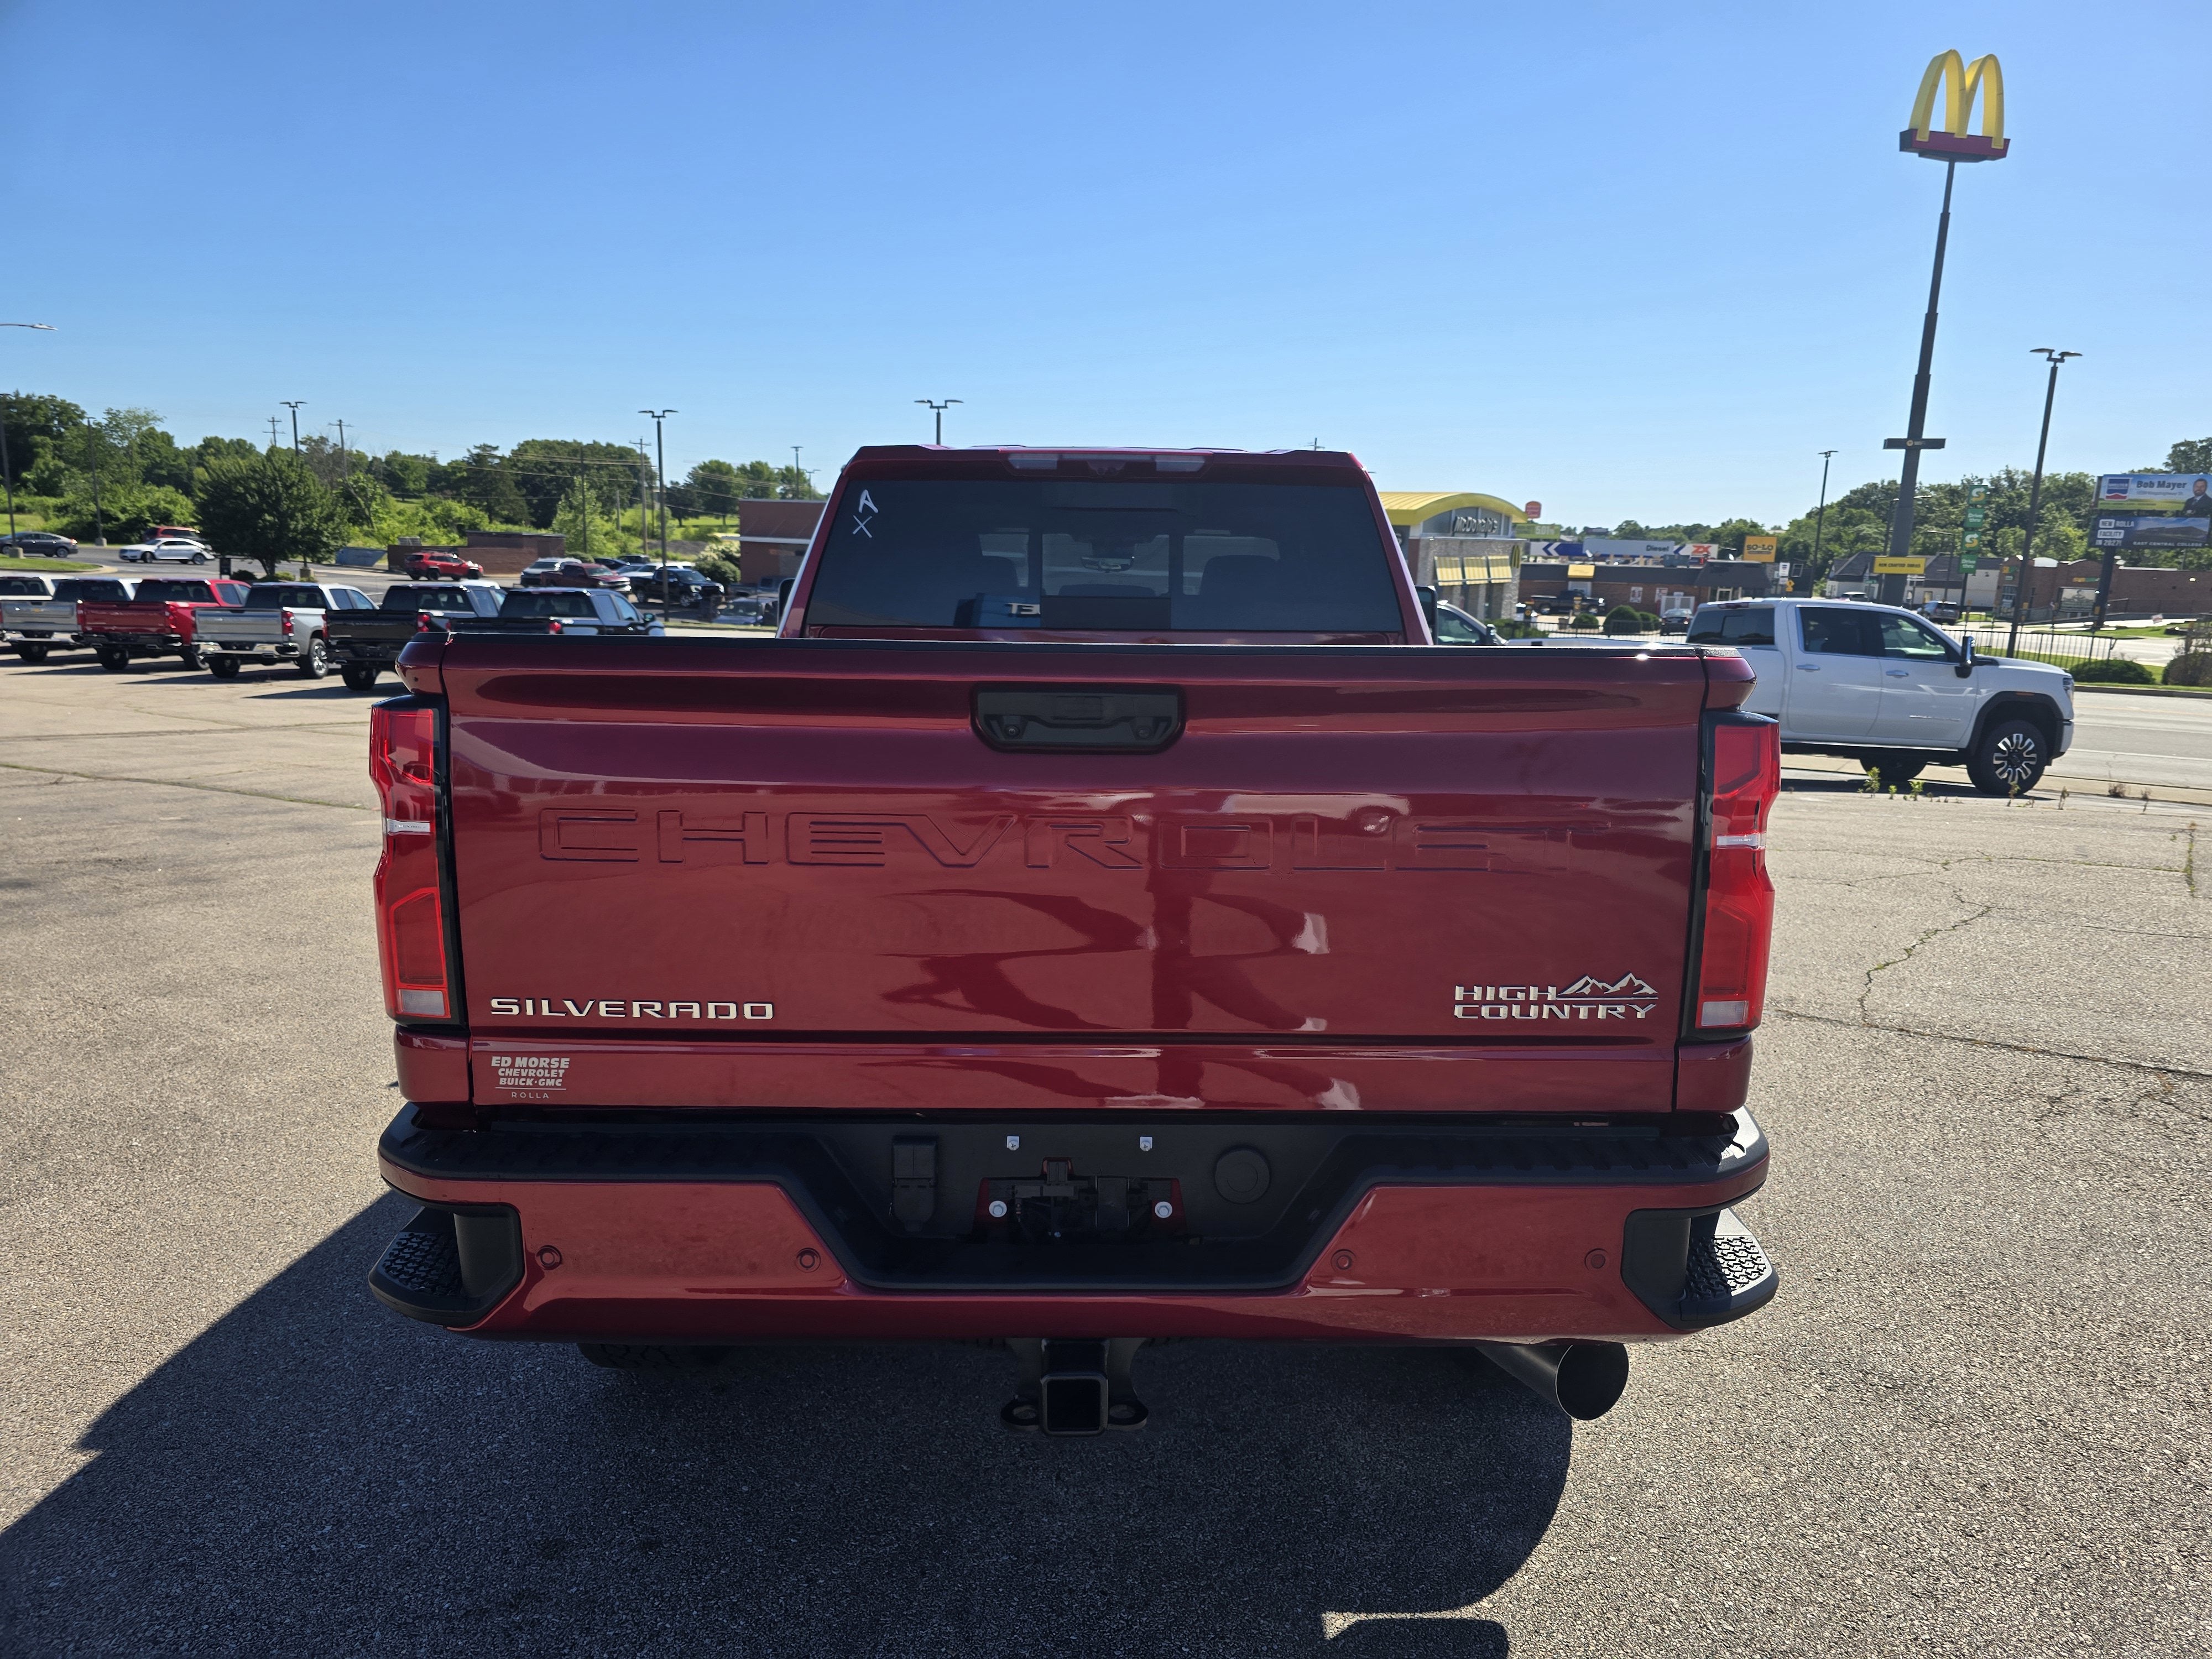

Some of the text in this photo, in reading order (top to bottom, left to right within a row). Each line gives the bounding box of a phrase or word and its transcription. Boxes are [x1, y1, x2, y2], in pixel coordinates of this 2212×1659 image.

[2136, 480, 2154, 488] Bob
[2157, 481, 2187, 491] Mayer
[858, 489, 879, 513] A
[1453, 516, 1498, 534] McDonald's
[1454, 985, 1557, 1001] HIGH
[490, 998, 774, 1020] SILVERADO
[1454, 1004, 1656, 1020] COUNTRY
[491, 1056, 570, 1068] ED MORSE
[498, 1068, 565, 1077] CHEVROLET
